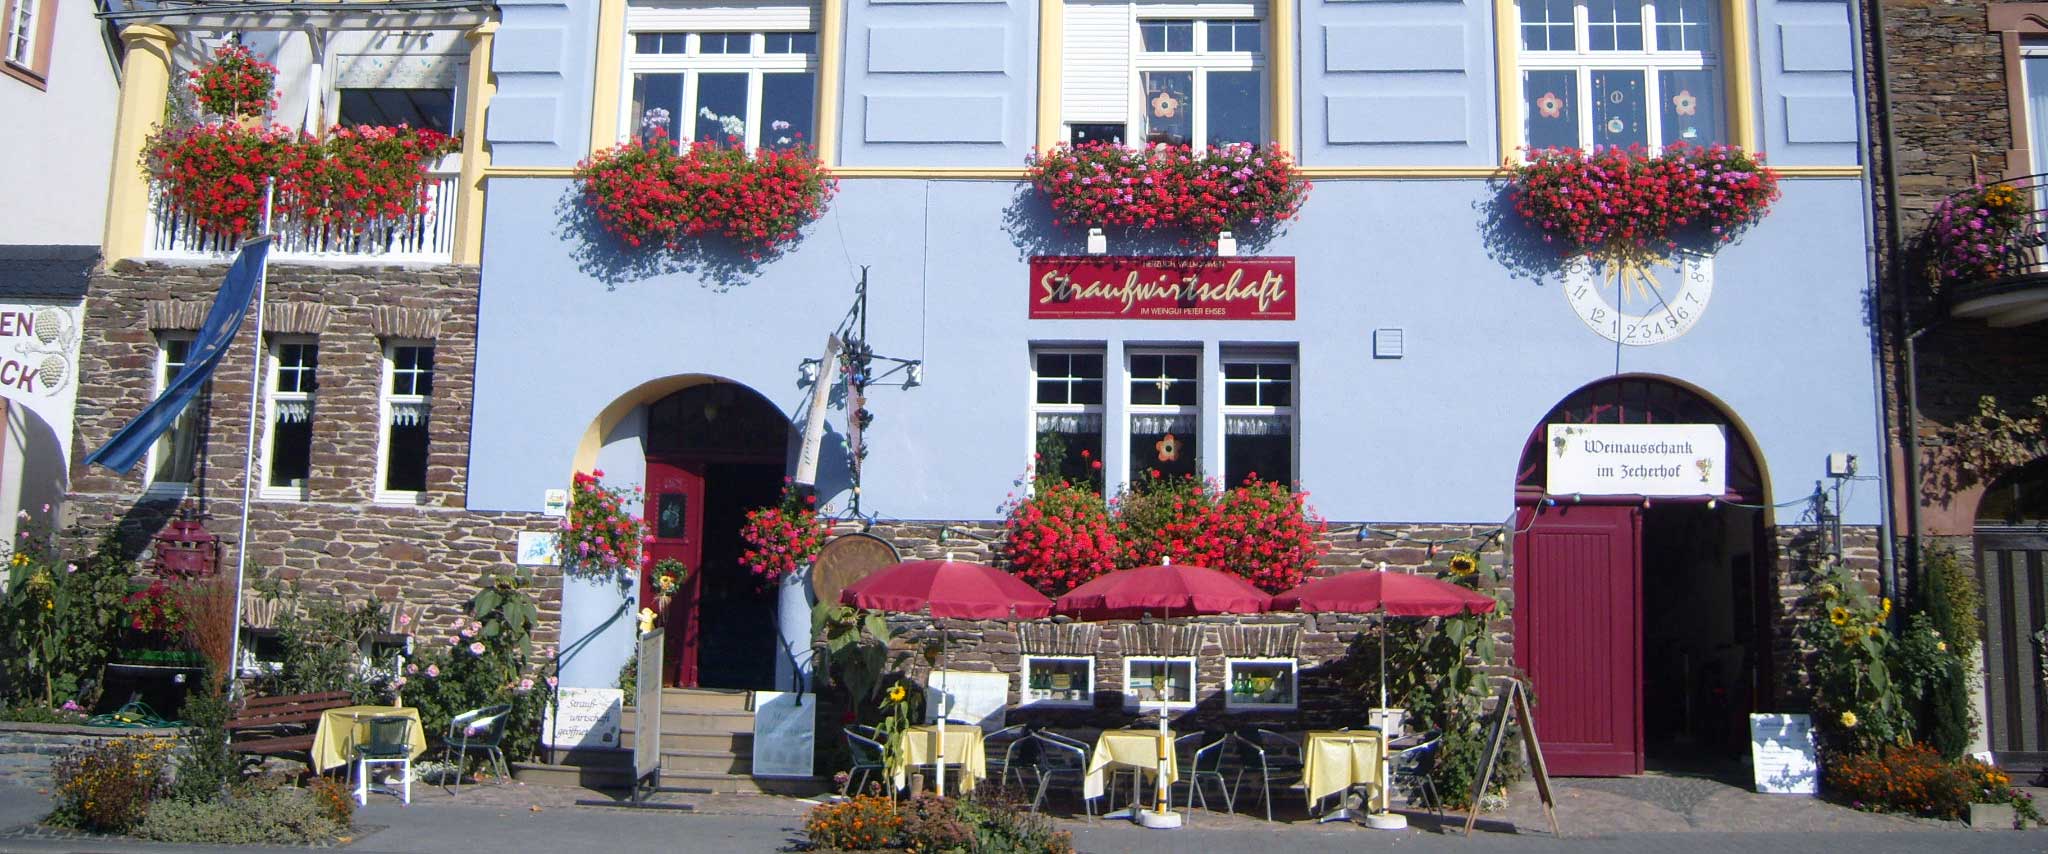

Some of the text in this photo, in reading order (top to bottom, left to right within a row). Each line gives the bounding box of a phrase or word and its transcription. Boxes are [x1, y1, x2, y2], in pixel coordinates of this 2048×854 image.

[1691, 272, 1704, 283] 8
[1573, 285, 1587, 299] 11
[1685, 291, 1699, 304] 7
[1141, 307, 1226, 315] IM WEINGUT PETER EHSES
[1590, 307, 1605, 323] 12
[1677, 306, 1689, 319] 6
[1611, 320, 1617, 334] 1
[1655, 322, 1664, 335] 4
[1665, 315, 1677, 329] 5
[1627, 324, 1637, 339] 2
[1642, 325, 1652, 339] 3
[0, 357, 40, 393] CK
[1584, 440, 1693, 455] Weinausschank
[1597, 464, 1682, 480] im Zecherhof
